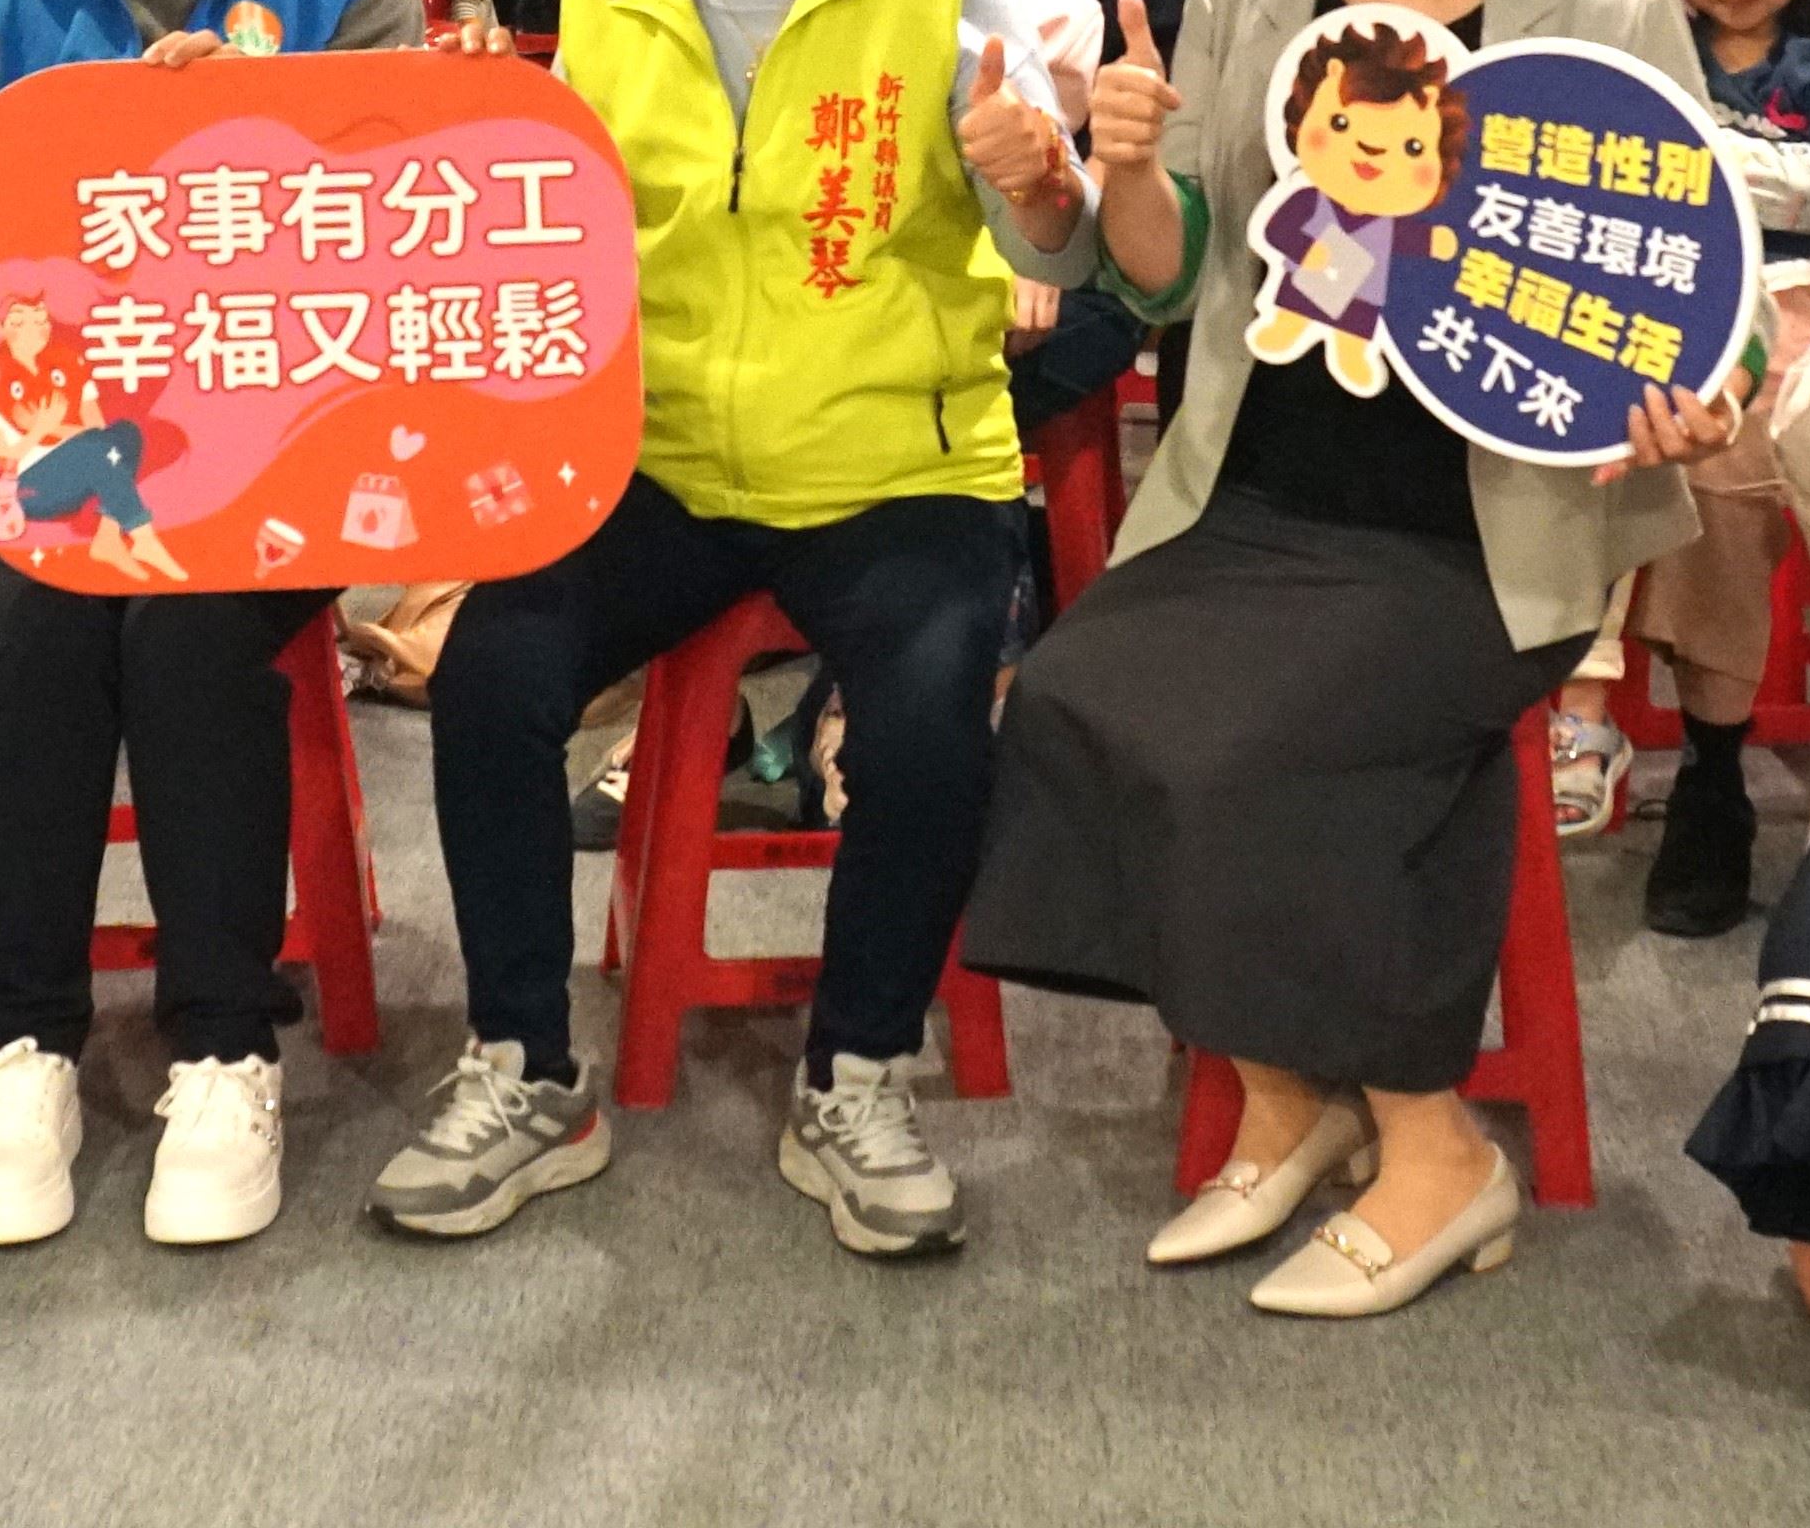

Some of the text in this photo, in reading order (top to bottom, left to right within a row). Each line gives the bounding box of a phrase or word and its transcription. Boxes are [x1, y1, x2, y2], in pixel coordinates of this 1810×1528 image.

[76, 159, 585, 270] 家事有分工
[802, 92, 867, 300] 鄭美琴
[873, 71, 905, 234] 新竹縣議員
[1480, 112, 1713, 207] 營造性別
[1468, 182, 1702, 295] 友善環境
[81, 279, 588, 394] 幸福又輕鬆
[1416, 305, 1584, 438] 共下來
[1453, 246, 1684, 384] 幸福生活
